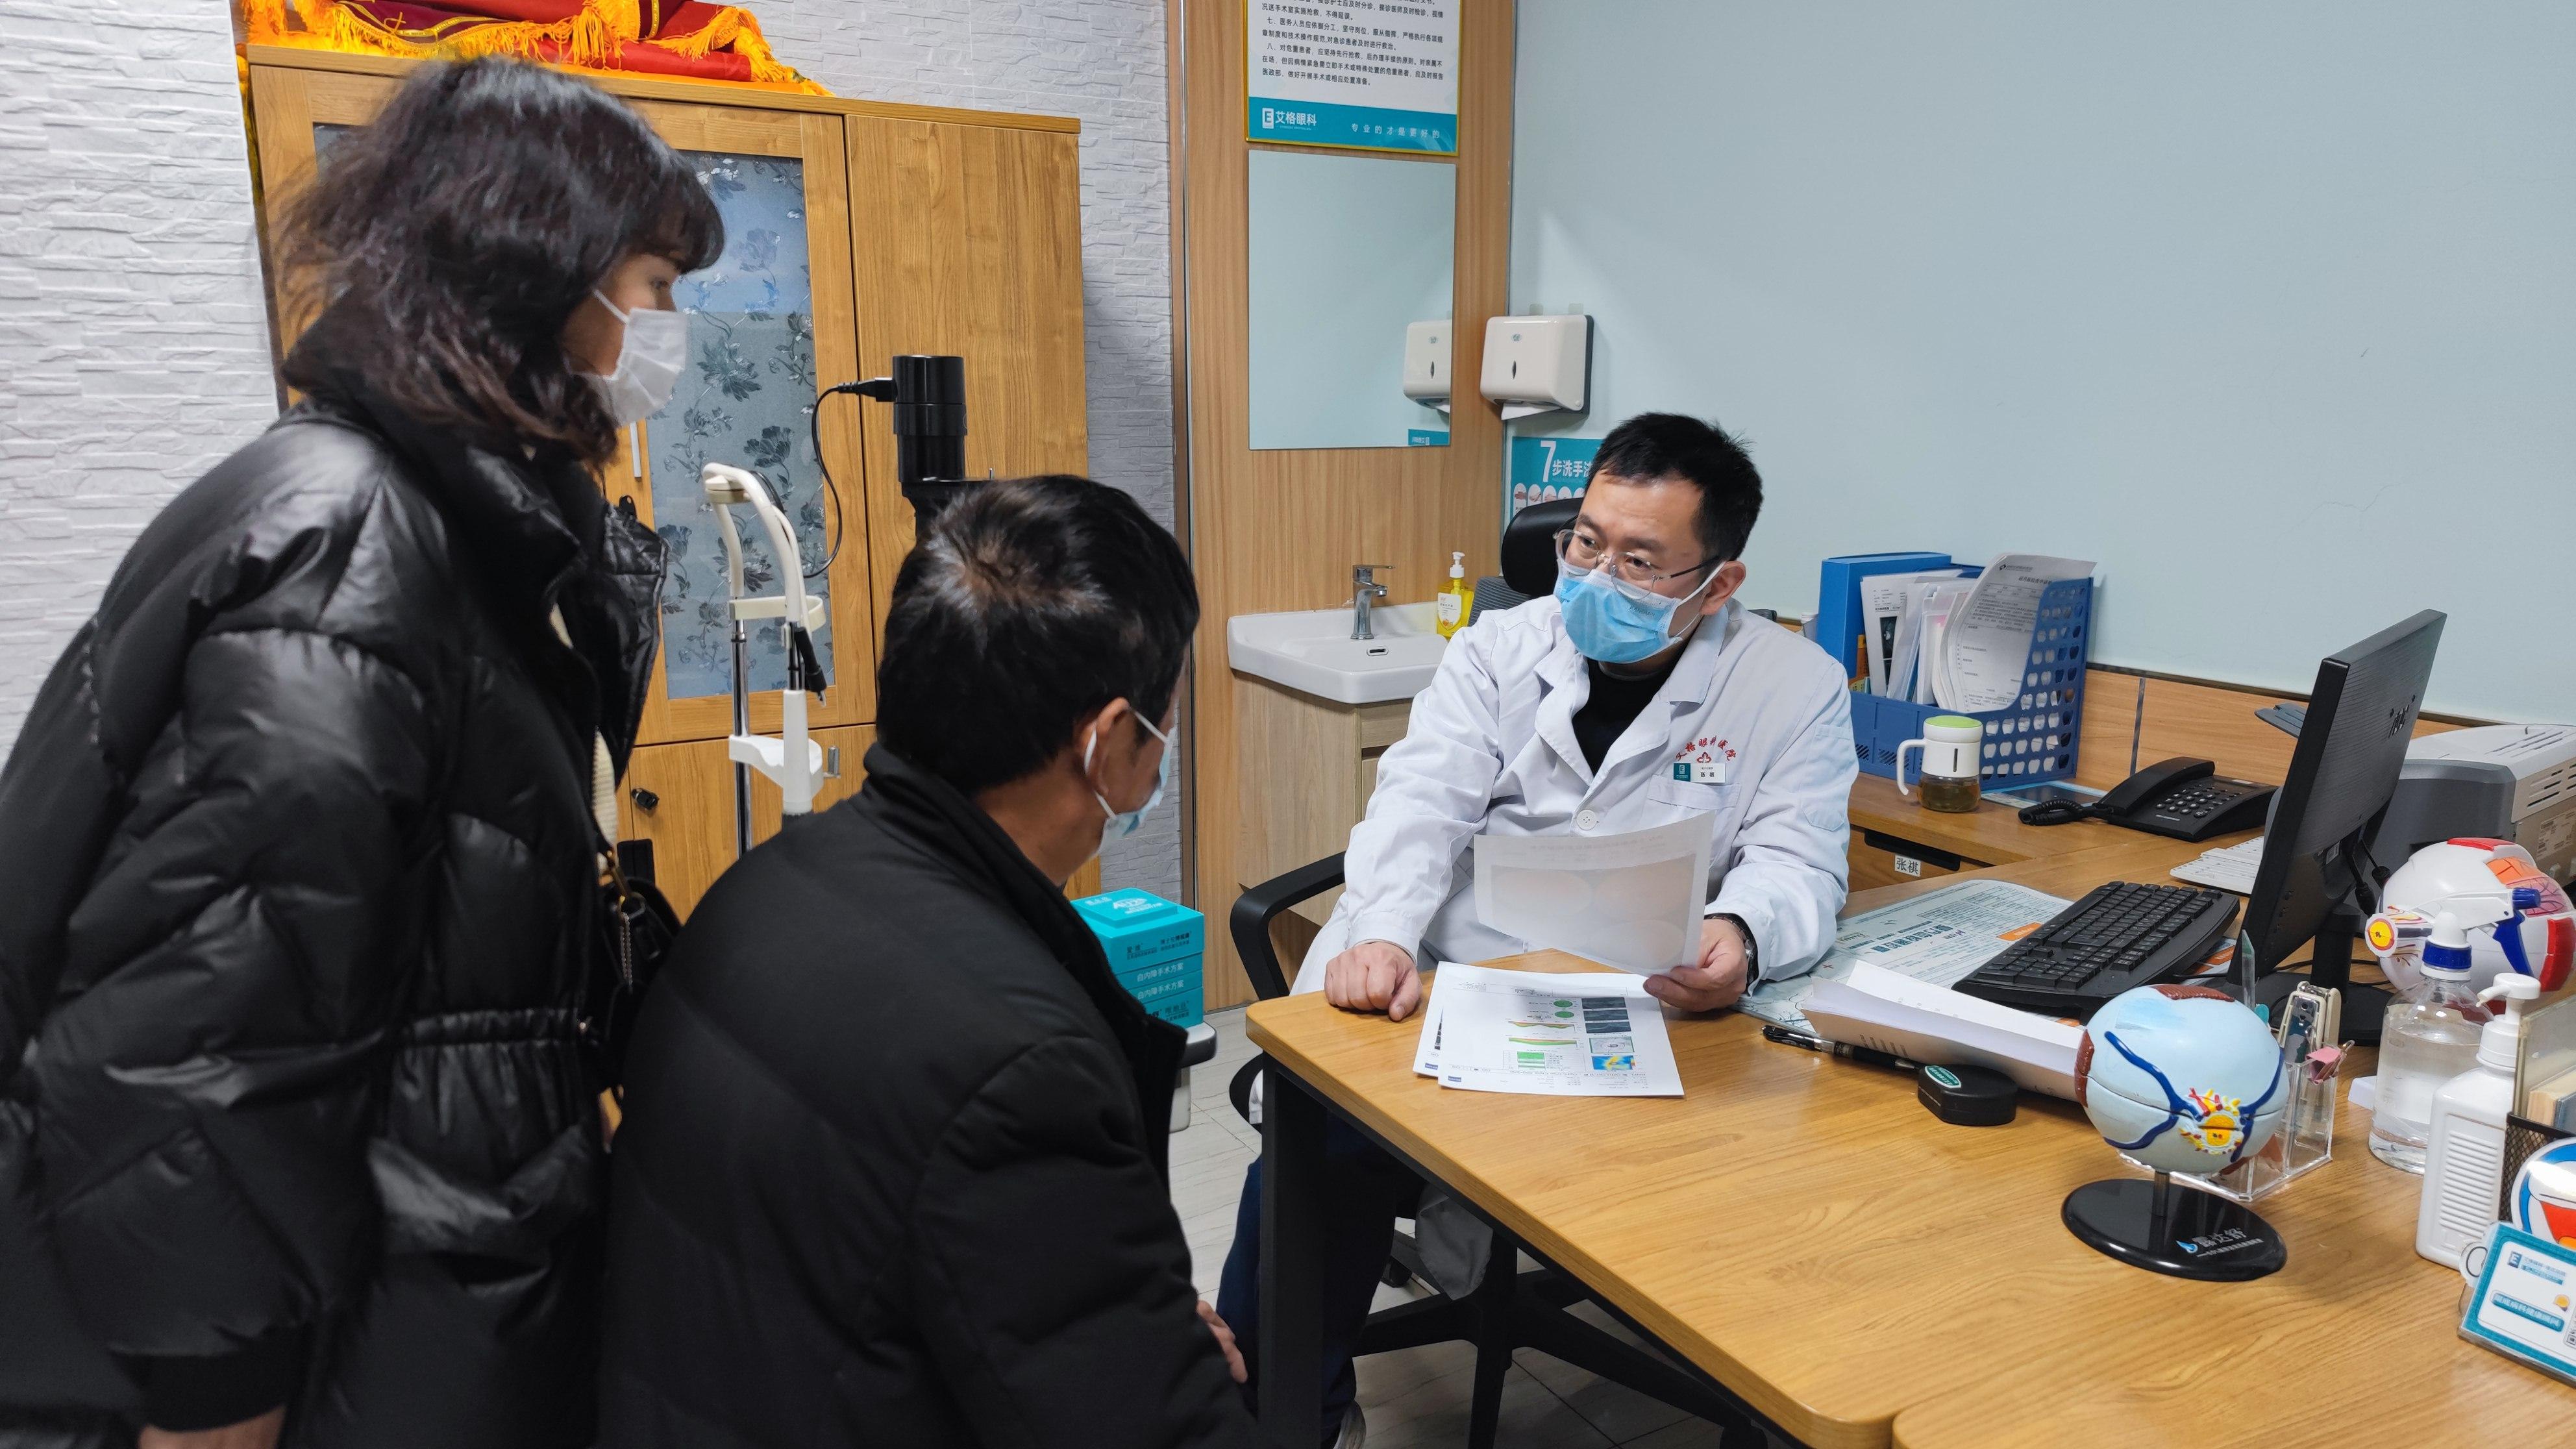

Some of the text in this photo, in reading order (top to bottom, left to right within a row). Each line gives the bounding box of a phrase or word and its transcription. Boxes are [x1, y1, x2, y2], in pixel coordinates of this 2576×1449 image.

[1275, 111, 1317, 126] 艾格眼科
[1352, 123, 1440, 139] 专业的才是更好的
[1896, 857, 1919, 875] 张祺
[1137, 962, 1184, 982] 白内障手术方案
[1137, 979, 1184, 1000] 白内障手术方案
